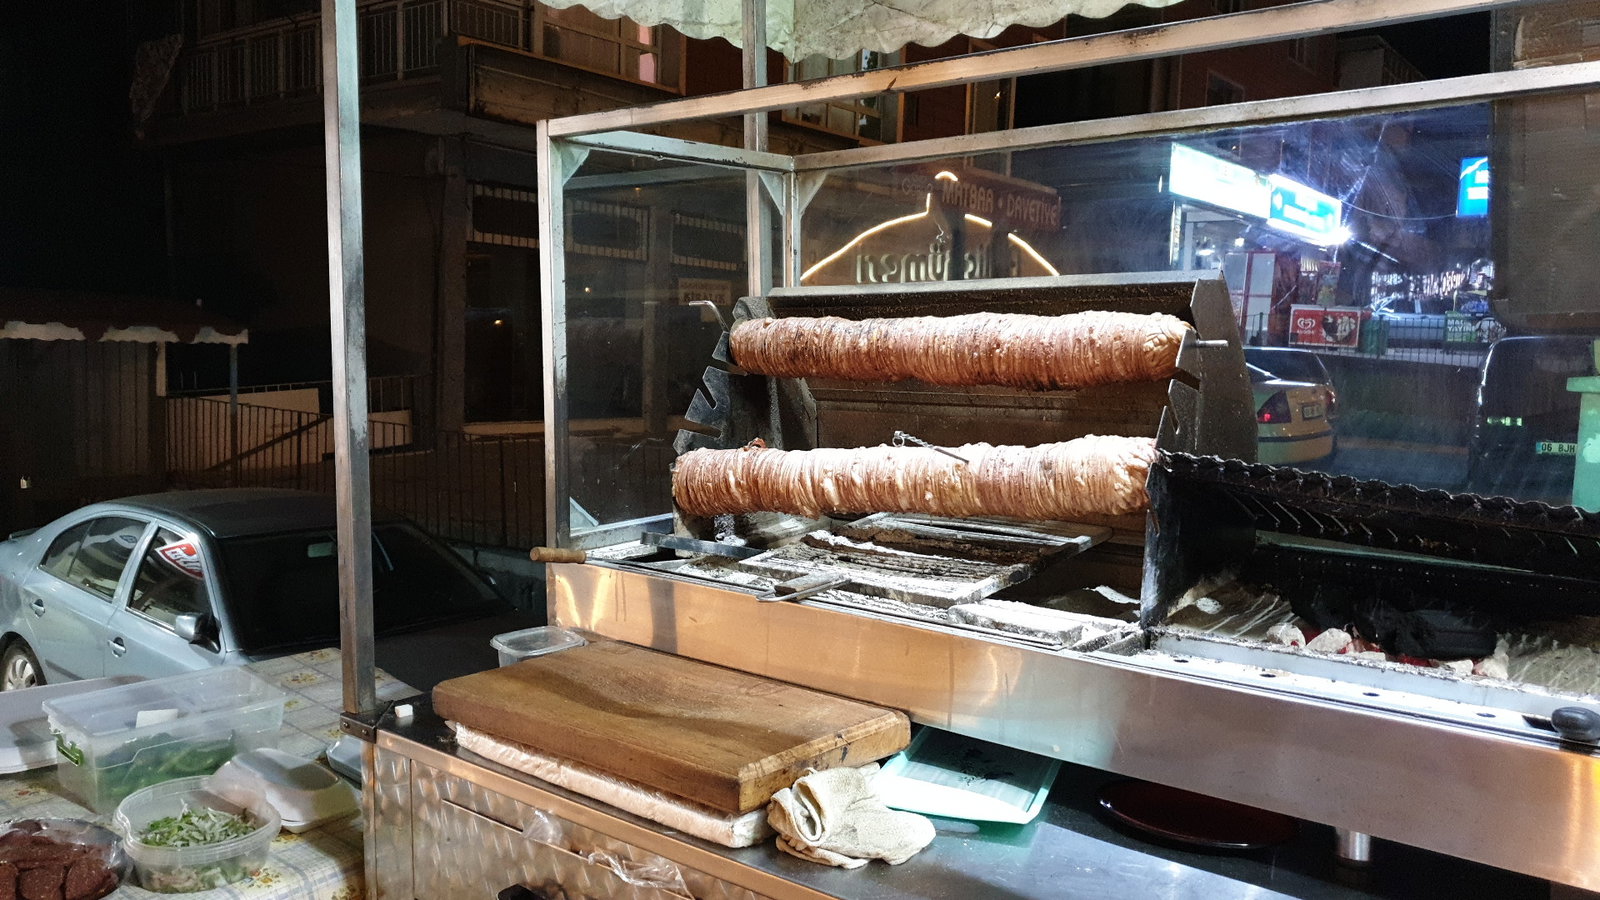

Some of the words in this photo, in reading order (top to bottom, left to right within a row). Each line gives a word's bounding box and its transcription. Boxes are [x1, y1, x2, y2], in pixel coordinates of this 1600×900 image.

[942, 179, 994, 214] MATBAA
[1541, 442, 1552, 452] 06
[1558, 443, 1575, 453] BJH
